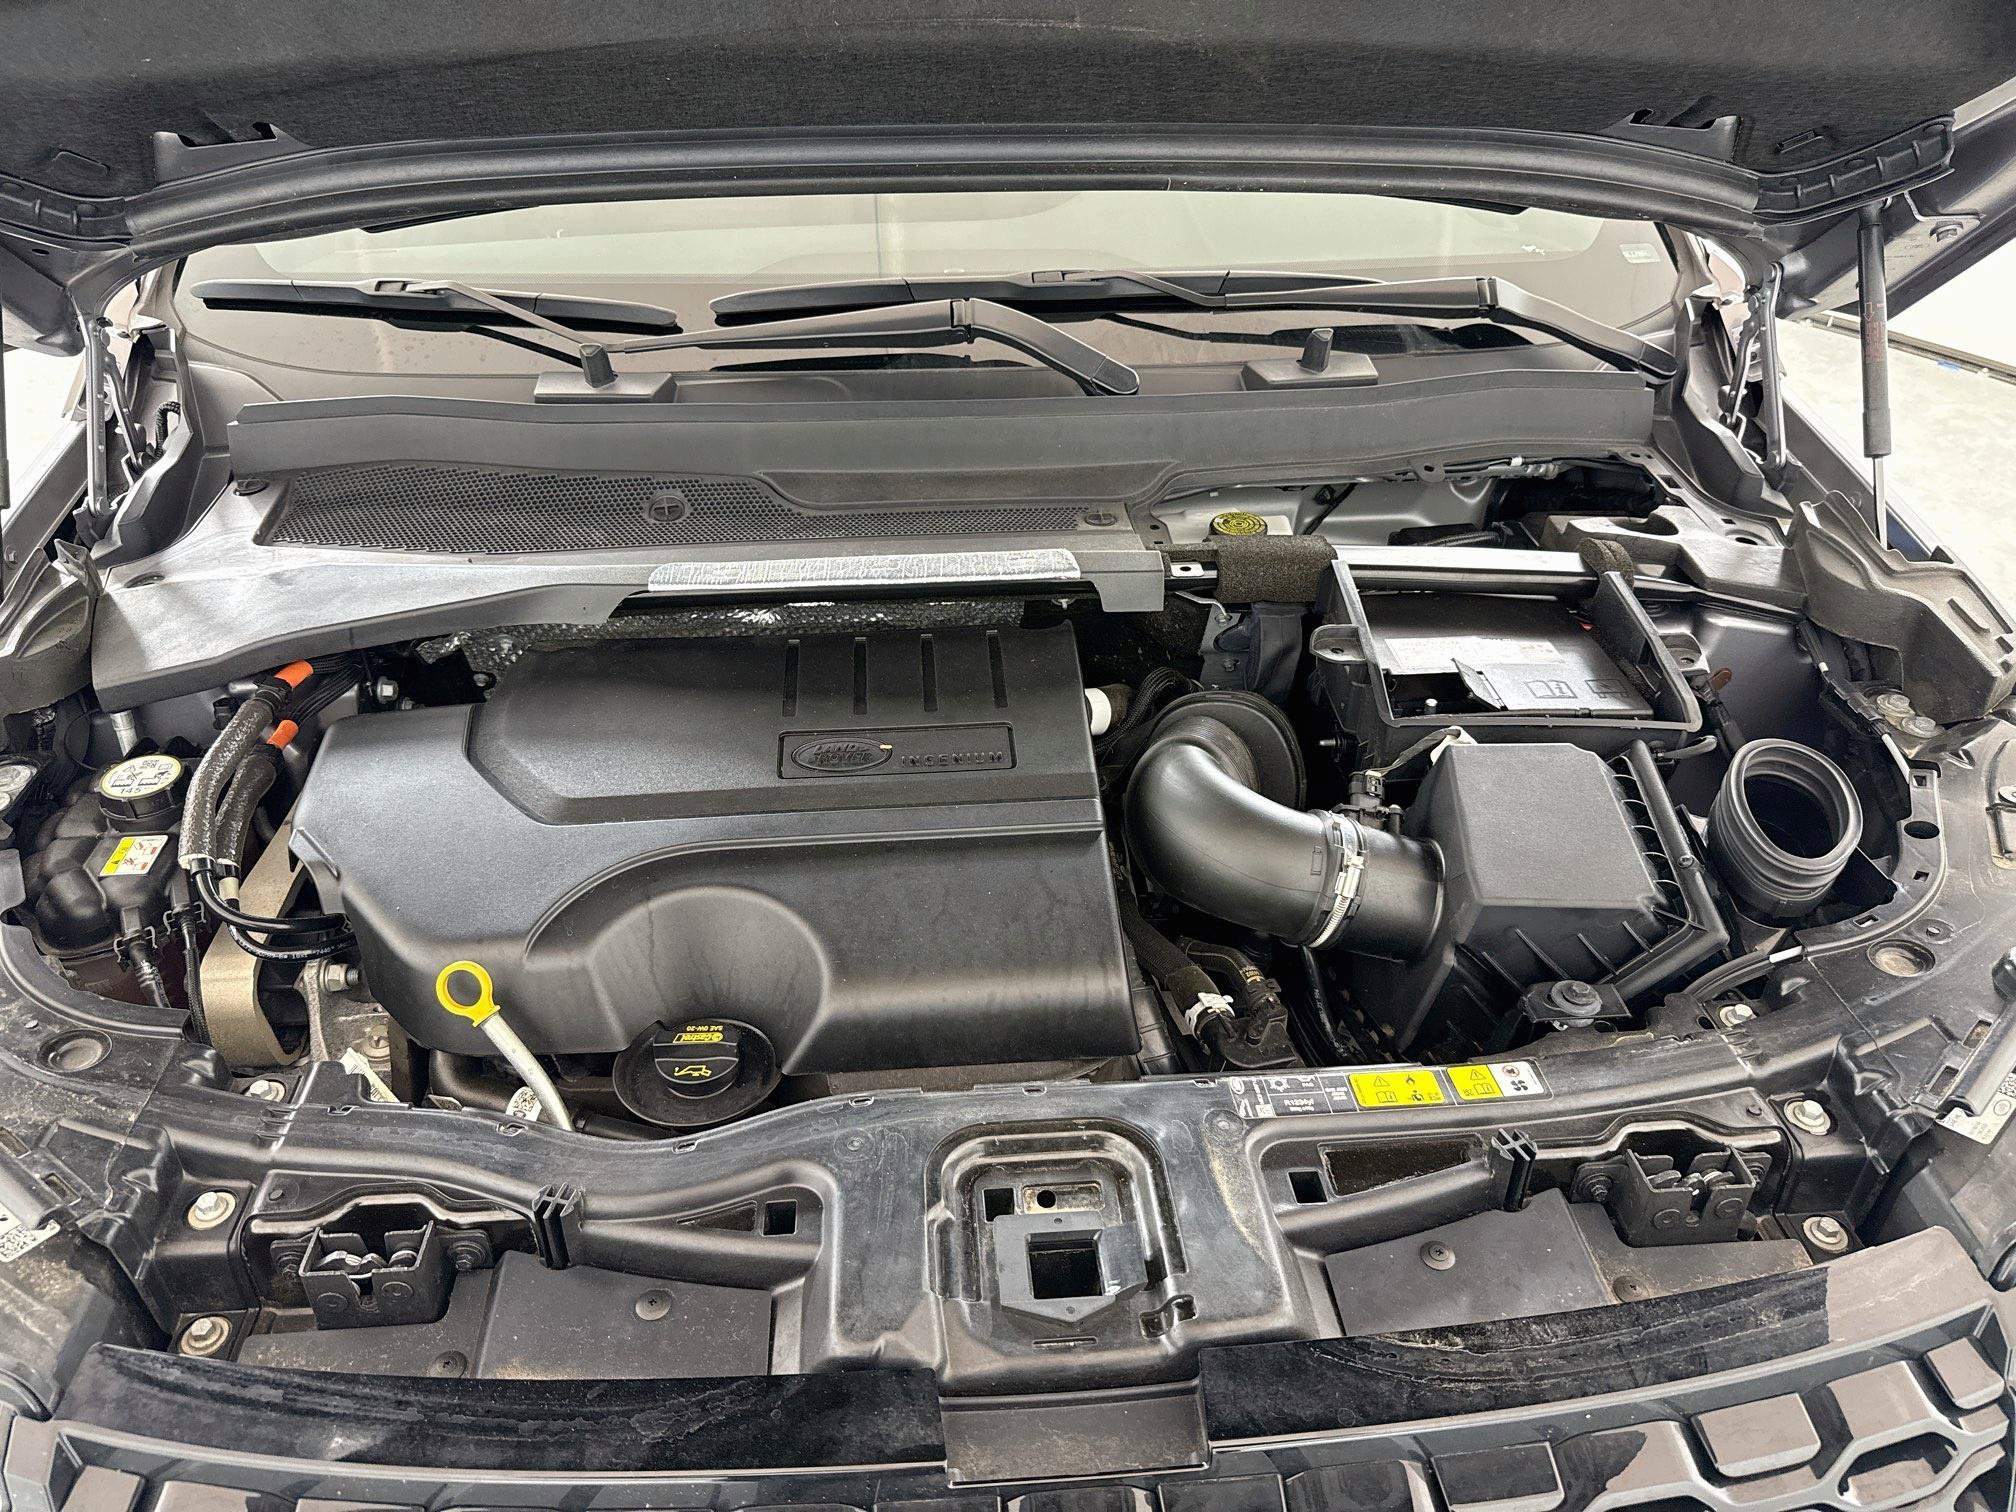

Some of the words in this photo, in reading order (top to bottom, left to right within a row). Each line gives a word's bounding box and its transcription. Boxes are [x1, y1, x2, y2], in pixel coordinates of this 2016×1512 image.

[813, 743, 863, 754] LAND
[813, 752, 873, 765] ROVER
[901, 751, 1003, 767] INGENIUM
[683, 1033, 713, 1042] Castrol
